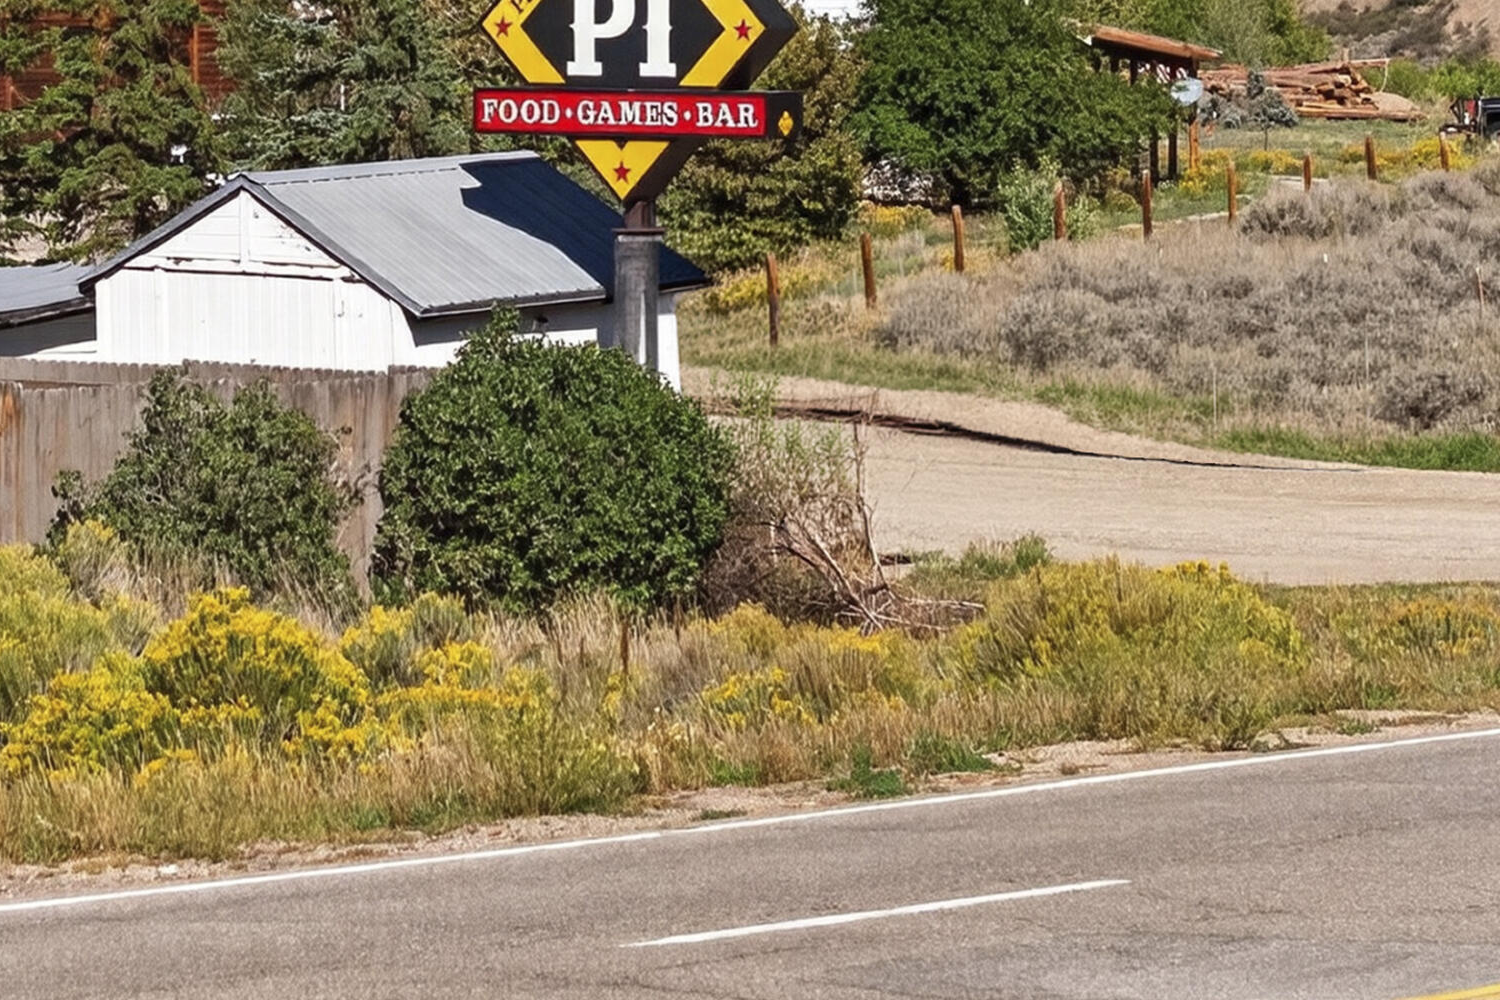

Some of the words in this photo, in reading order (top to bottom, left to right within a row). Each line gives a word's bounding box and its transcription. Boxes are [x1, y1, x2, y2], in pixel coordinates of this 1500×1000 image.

[481, 98, 561, 124] FOOD
[577, 100, 679, 127] GAMES
[696, 102, 758, 128] BAR
